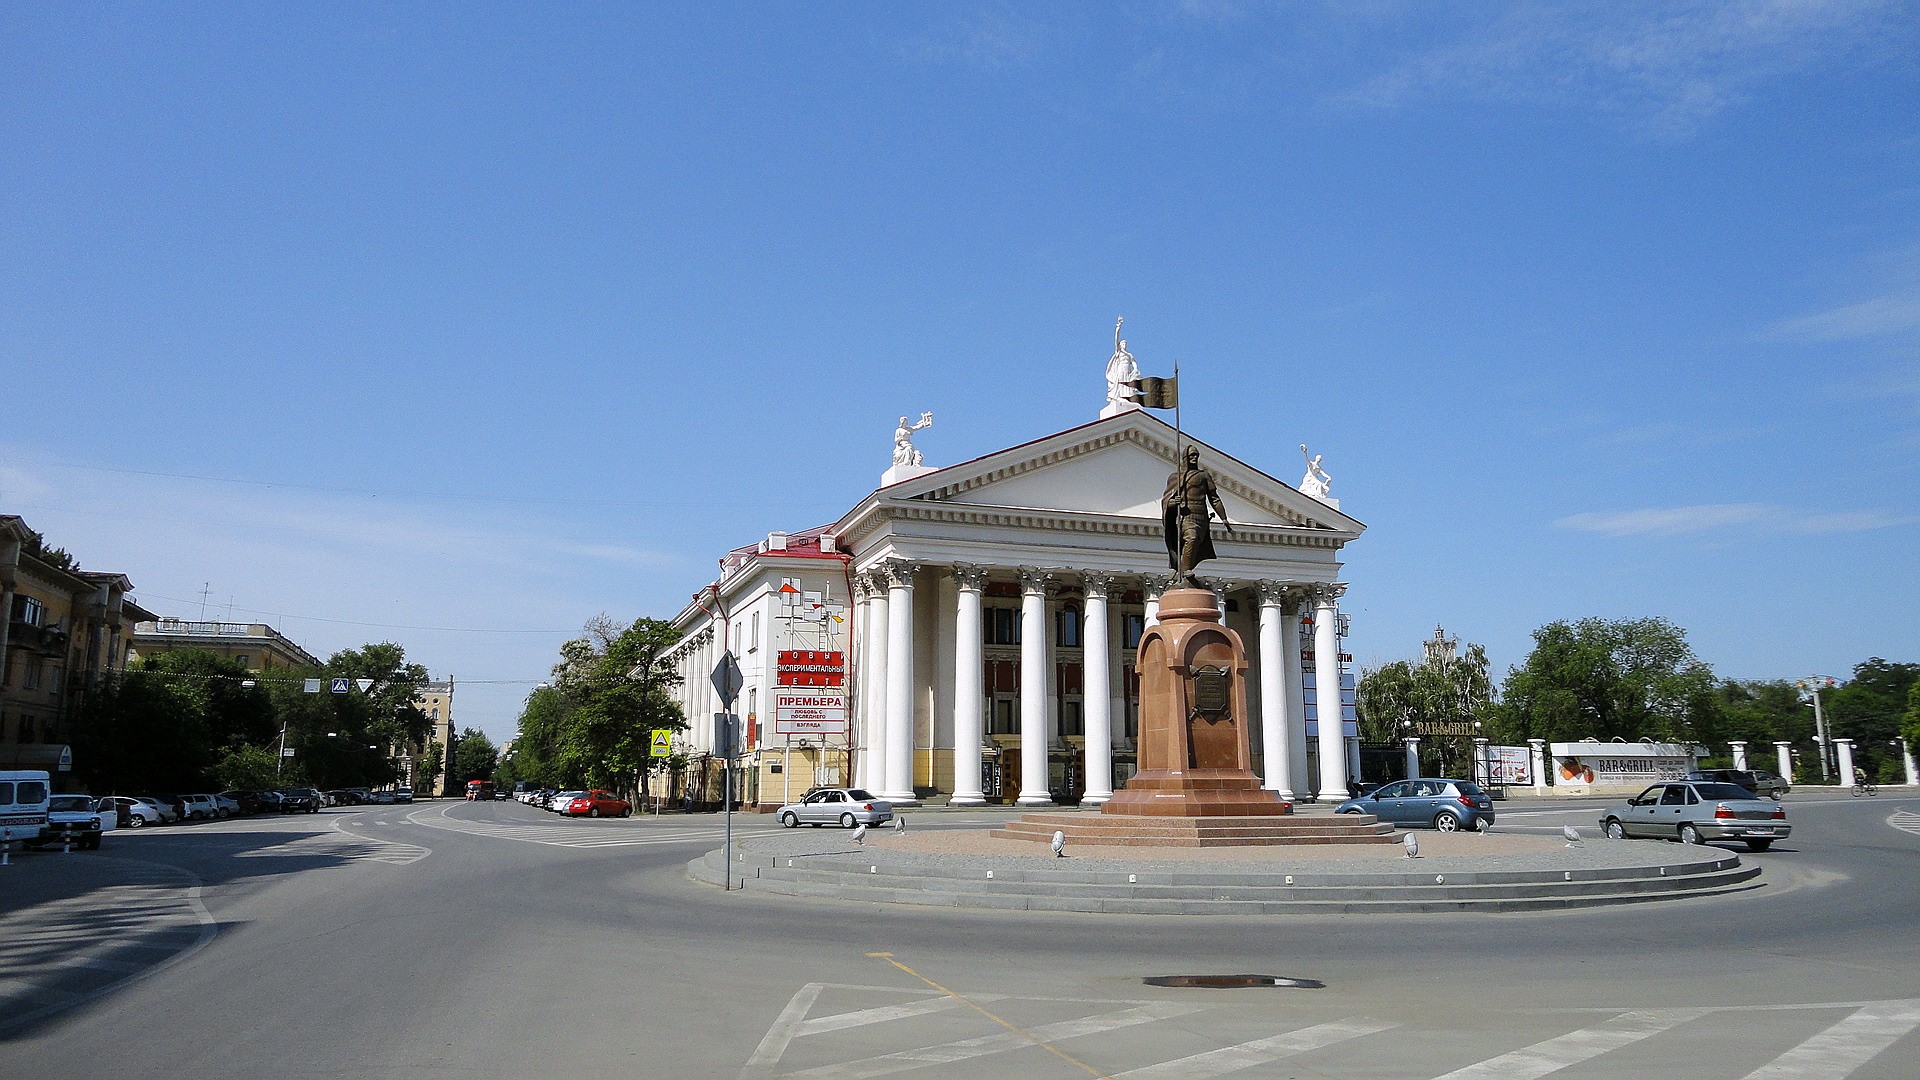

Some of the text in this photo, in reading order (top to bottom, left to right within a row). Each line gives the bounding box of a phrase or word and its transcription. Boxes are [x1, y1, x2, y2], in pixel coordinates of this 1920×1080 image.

[777, 677, 845, 685] ТЕАТР
[779, 697, 842, 706] ПРЕМЬЕРА
[1599, 759, 1656, 772] BAR&GRILL
